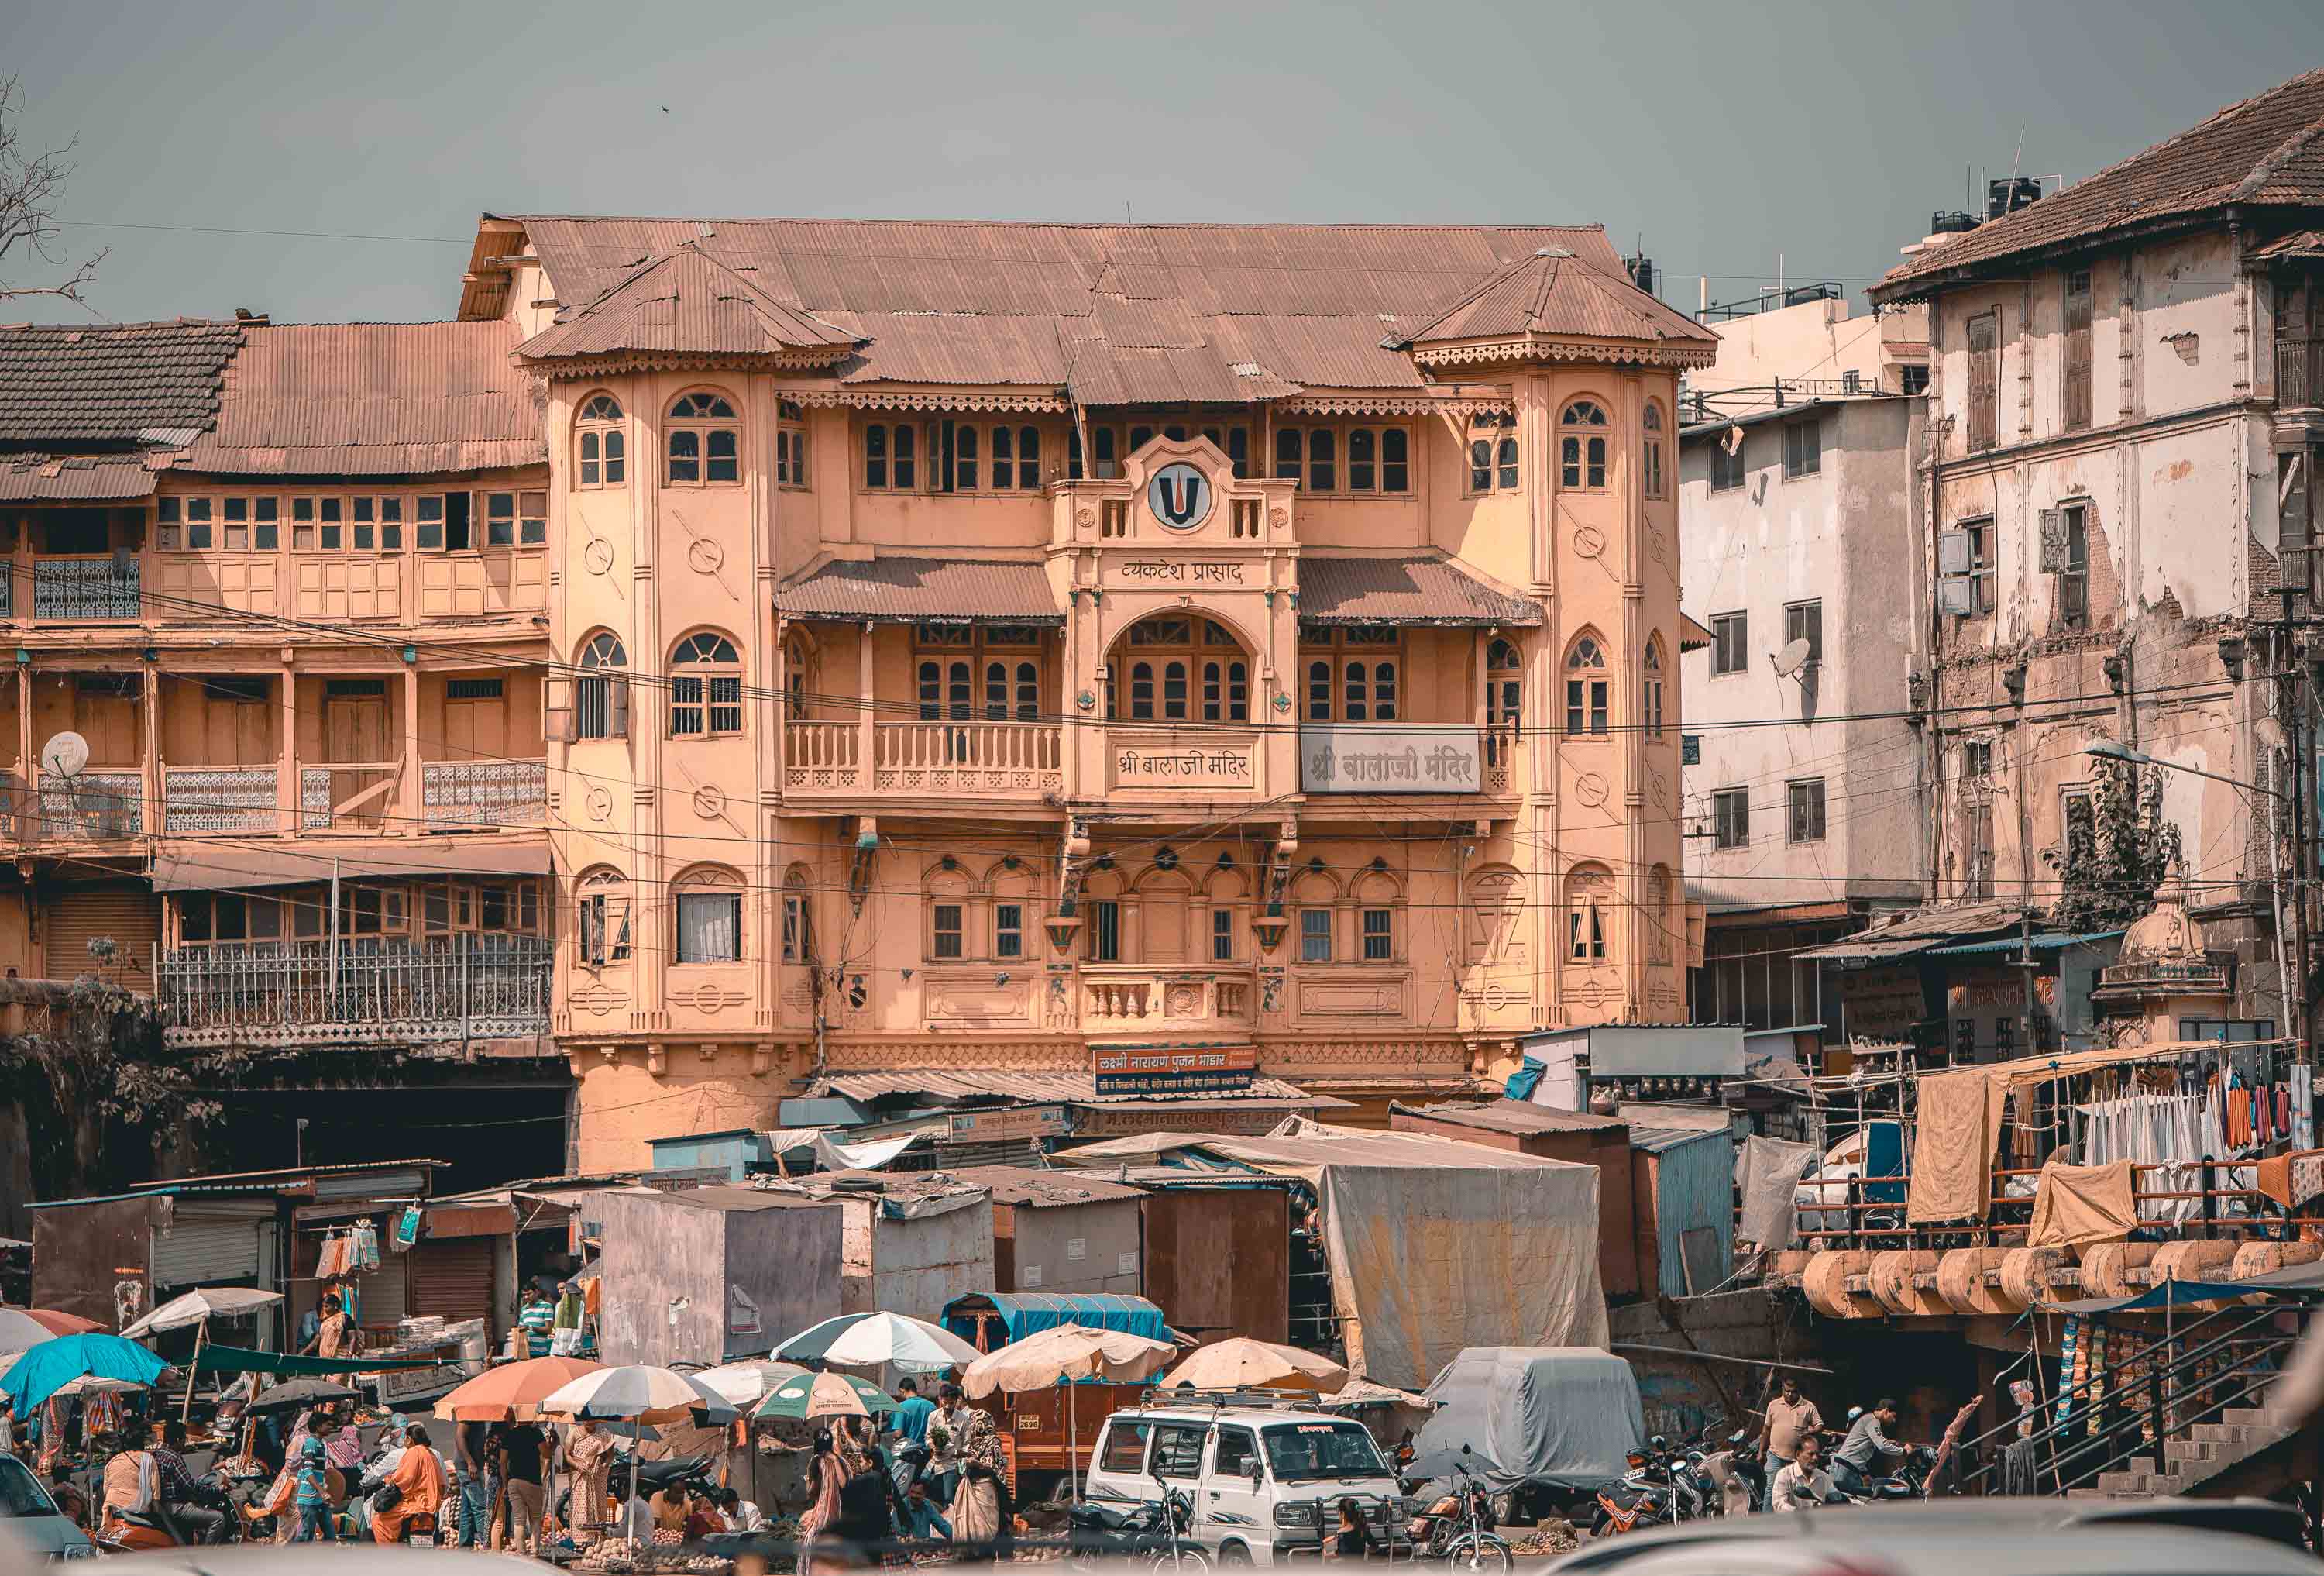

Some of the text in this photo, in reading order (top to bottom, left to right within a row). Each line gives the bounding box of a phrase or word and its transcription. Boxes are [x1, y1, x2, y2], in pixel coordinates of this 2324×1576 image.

[1122, 559, 1244, 584] व्यंकटेश प्रासाद
[1119, 750, 1249, 780] श्री बालाजी मंदिर
[1311, 745, 1473, 783] श्री बालाजी मंदिर
[1099, 1052, 1129, 1070] लक्ष्मी
[1130, 1056, 1169, 1068] नारायण
